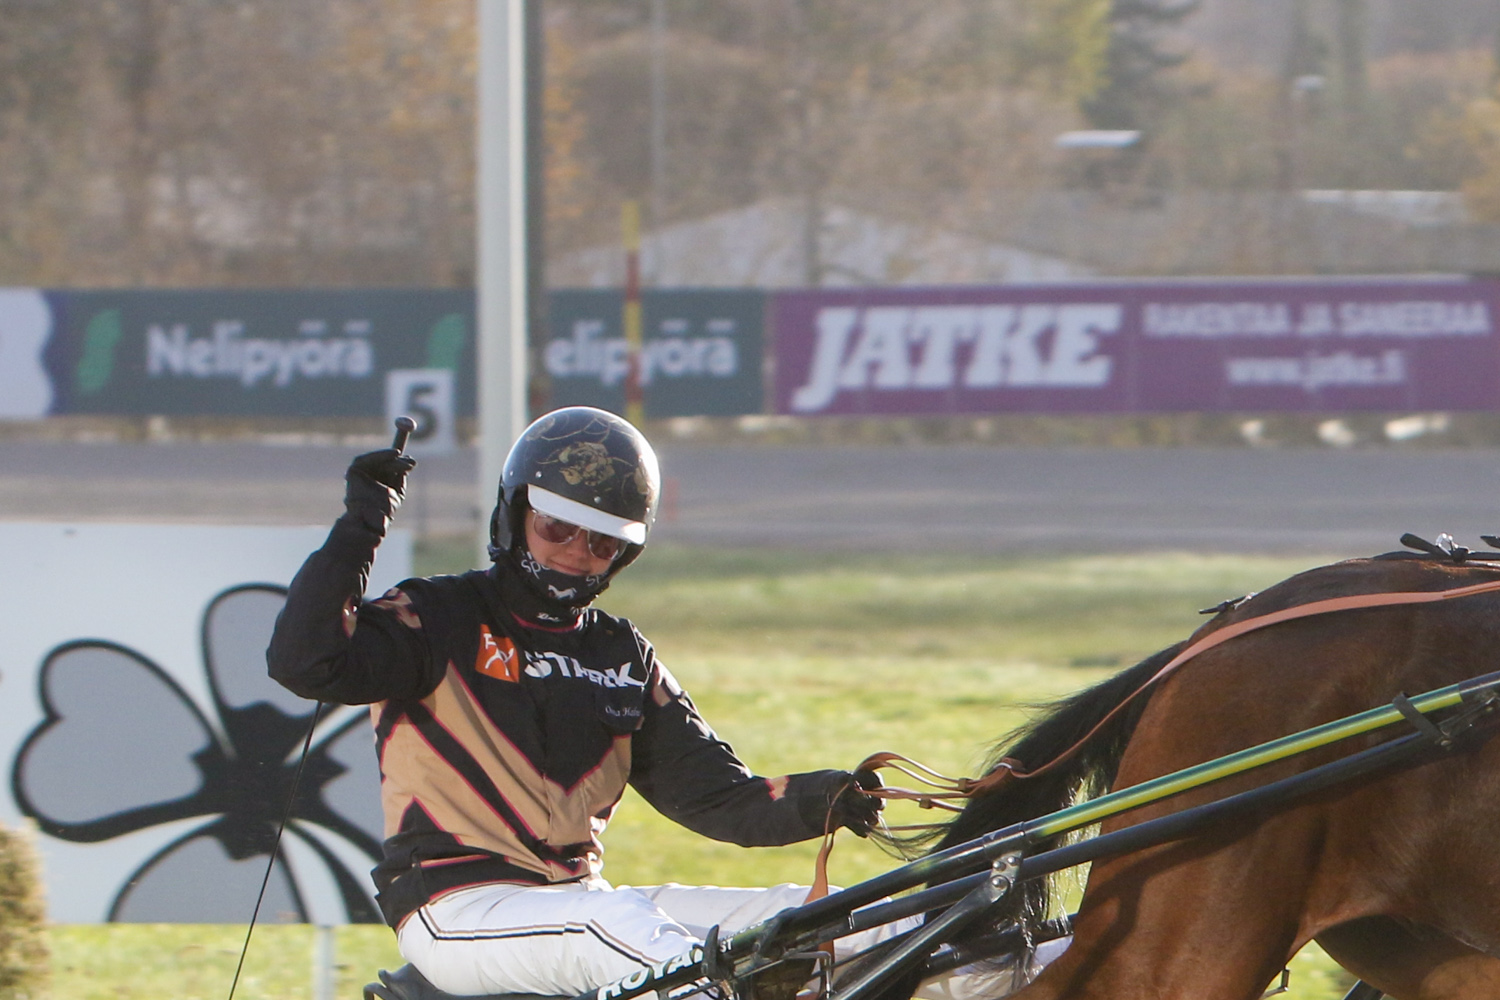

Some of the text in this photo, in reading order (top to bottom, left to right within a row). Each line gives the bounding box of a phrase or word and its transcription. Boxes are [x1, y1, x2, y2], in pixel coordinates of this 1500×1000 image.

[147, 320, 374, 387] Nelipyörä
[792, 304, 1122, 412] JATKE
[404, 383, 438, 442] 5
